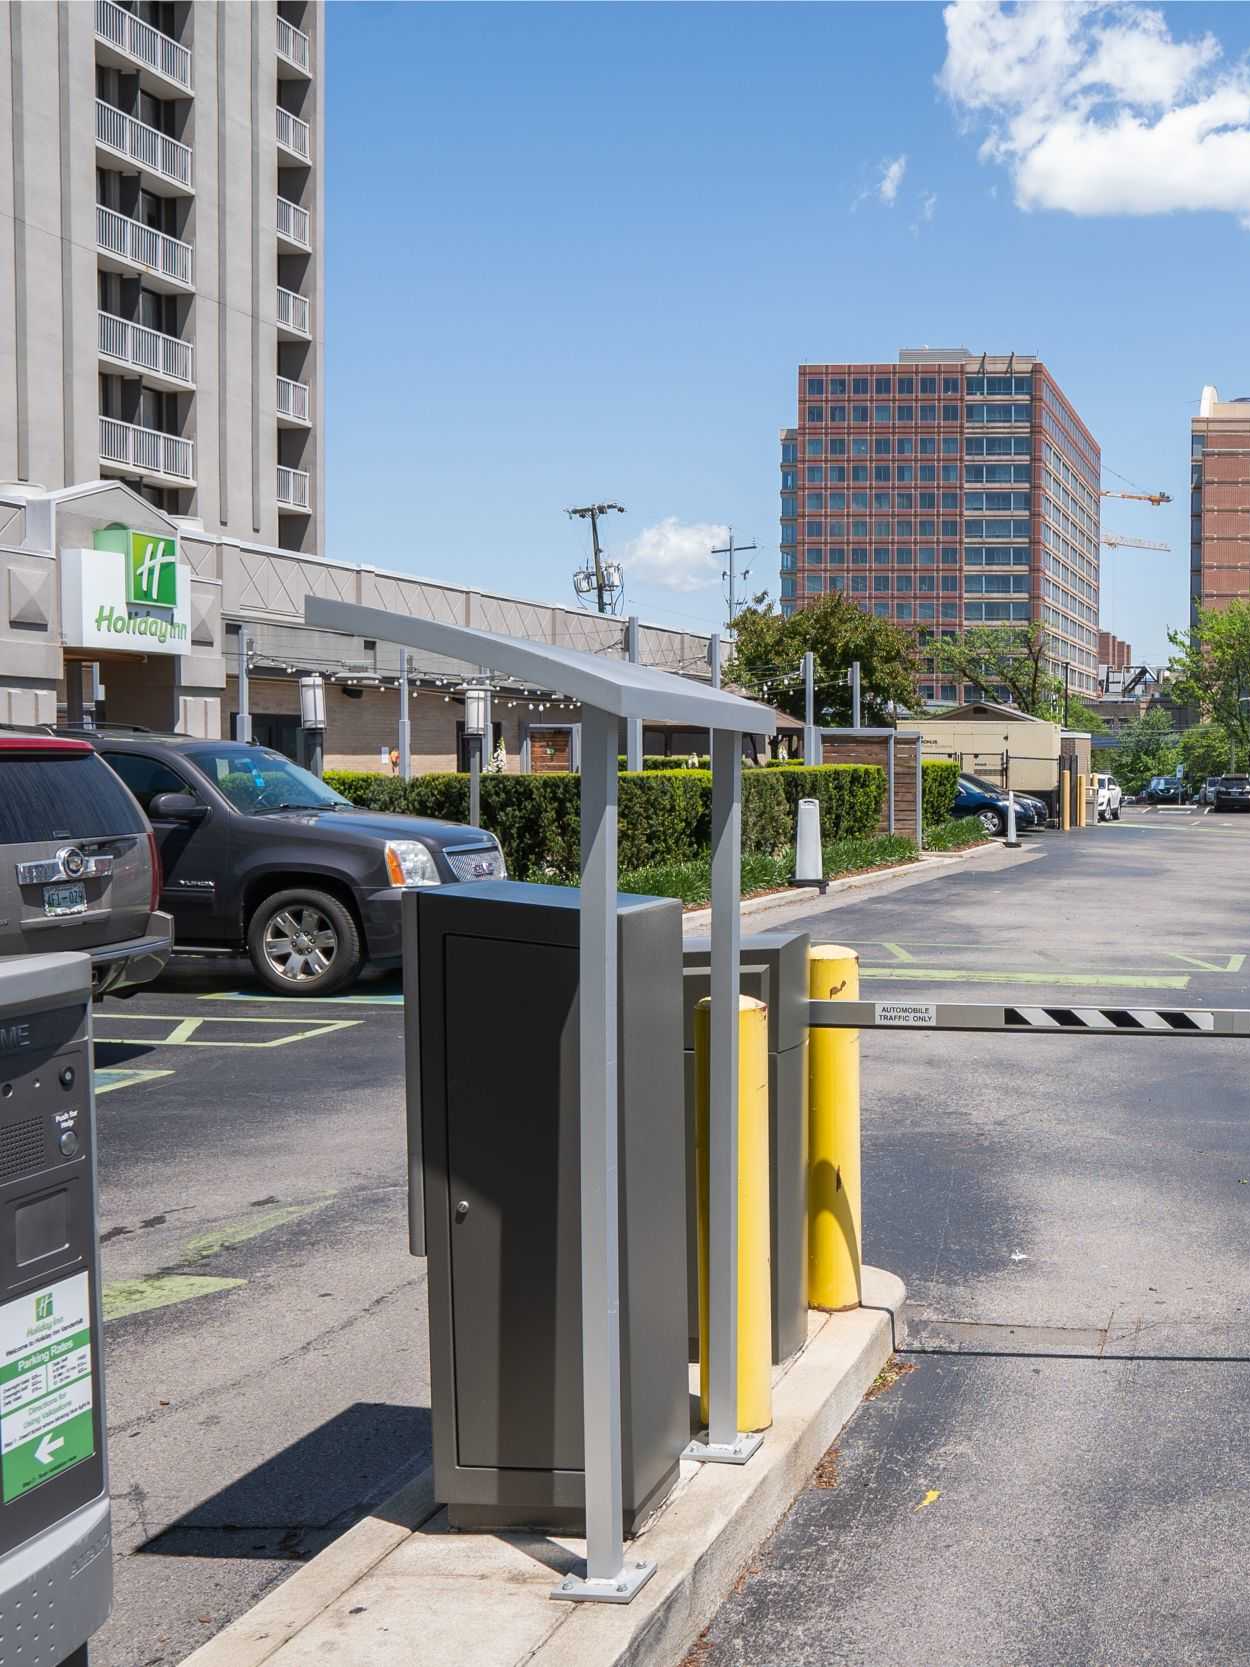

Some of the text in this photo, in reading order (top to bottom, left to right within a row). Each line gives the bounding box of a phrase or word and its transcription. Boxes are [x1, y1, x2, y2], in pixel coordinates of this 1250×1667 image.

[95, 605, 187, 643] Holiday Inn
[179, 879, 217, 887] YUKON
[879, 1014, 910, 1022] TRAFFIC
[55, 1112, 69, 1123] Push
[60, 1119, 75, 1129] Help
[17, 1350, 50, 1372] Parking
[50, 1339, 74, 1358] Rates
